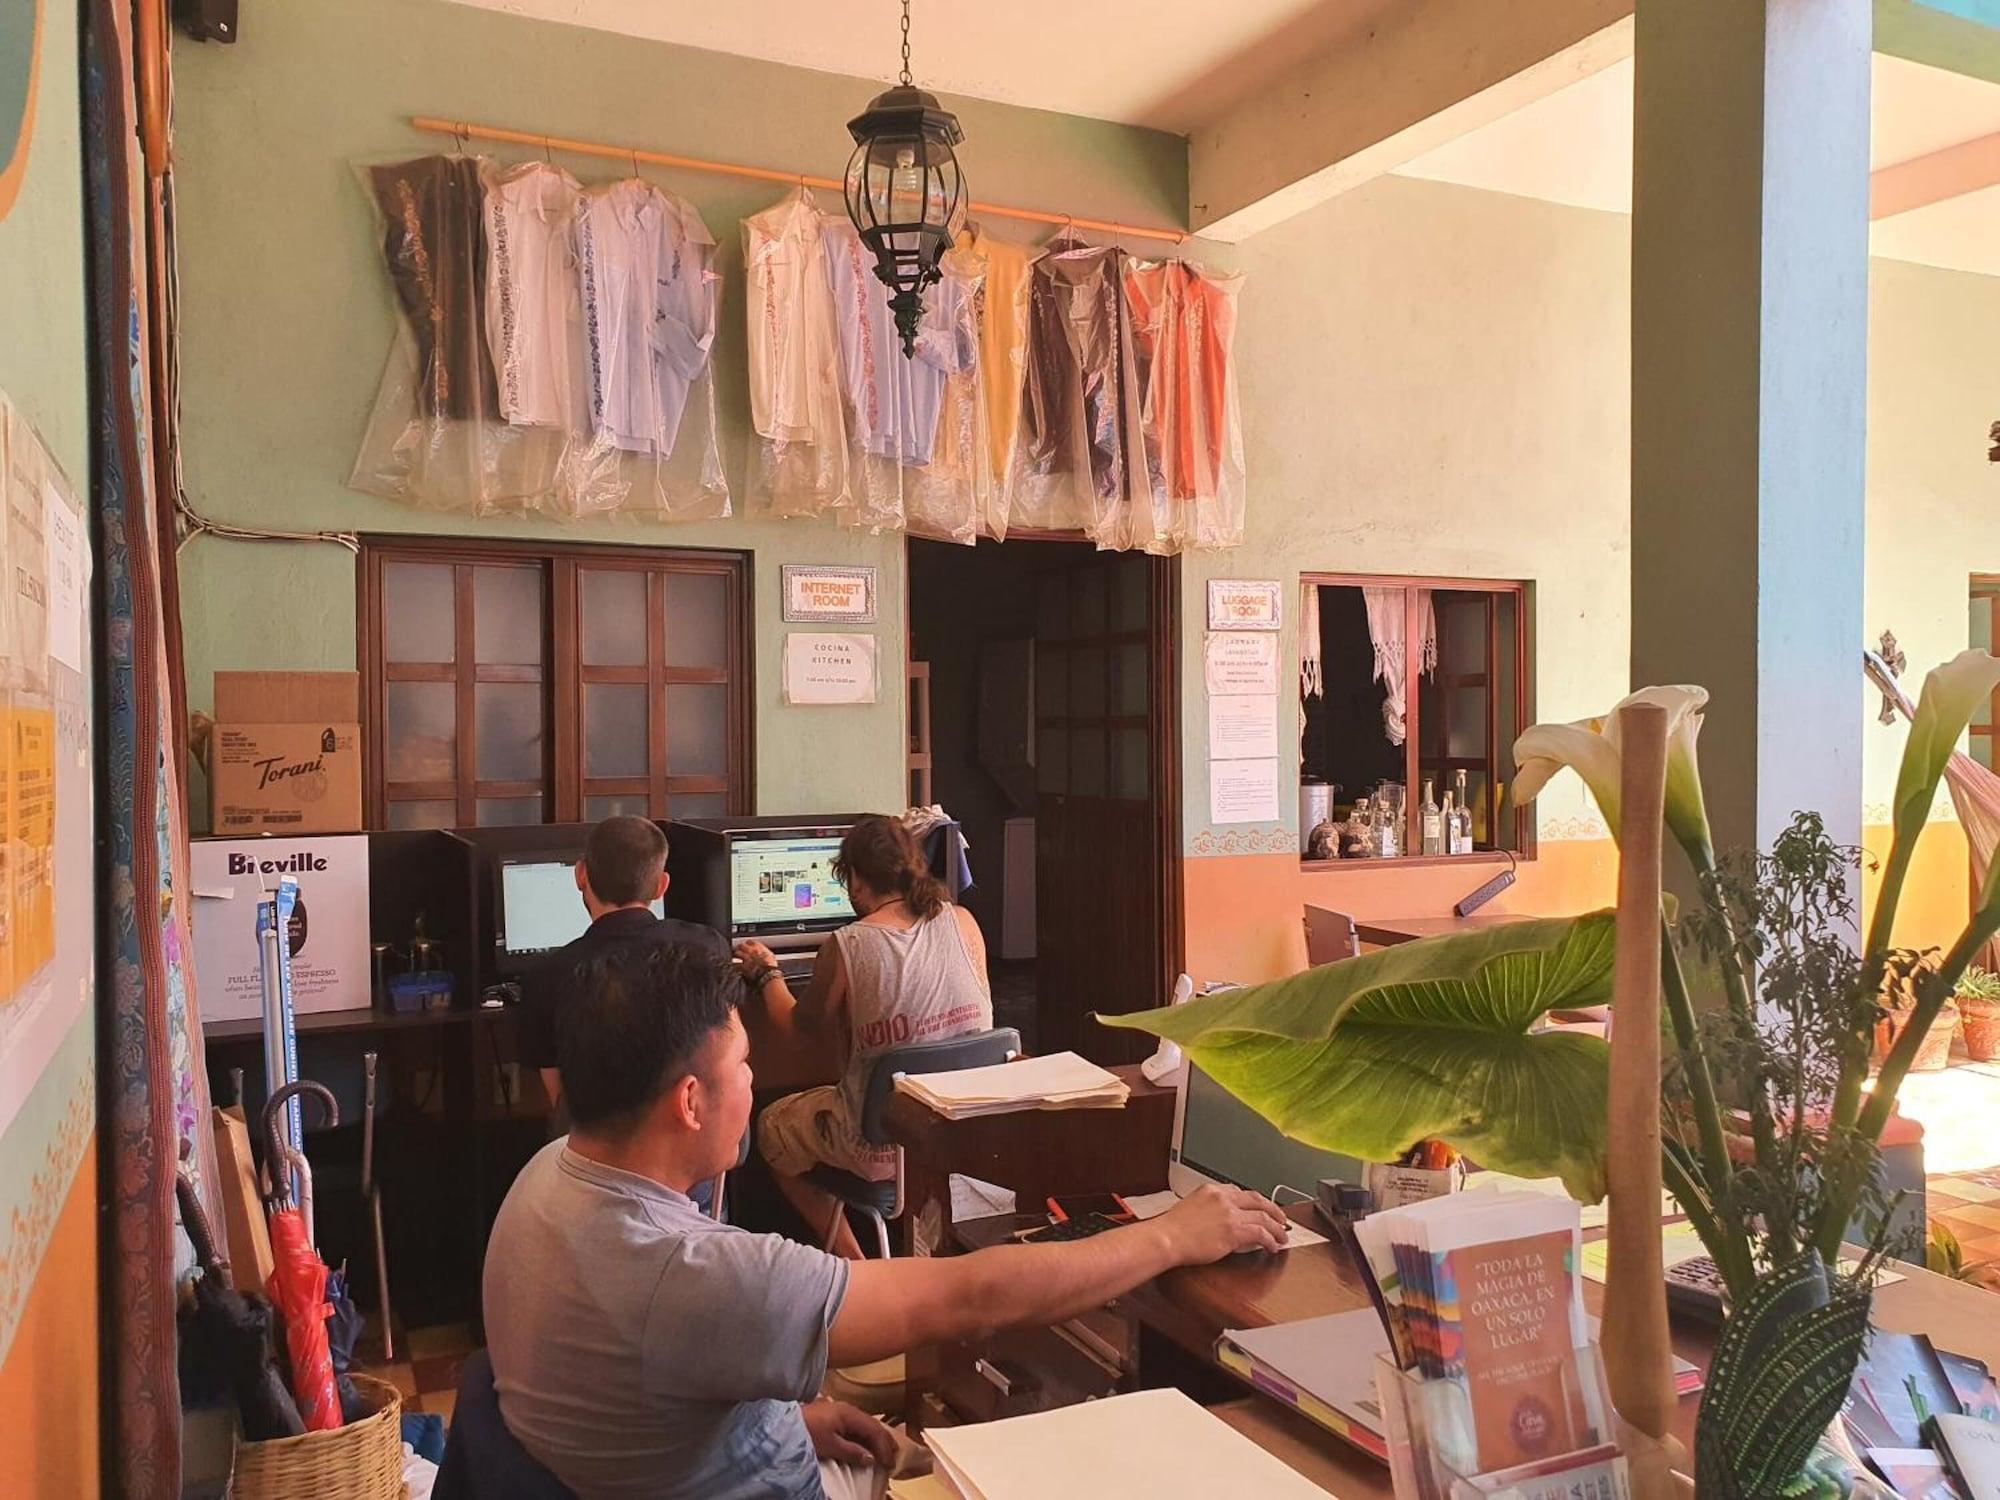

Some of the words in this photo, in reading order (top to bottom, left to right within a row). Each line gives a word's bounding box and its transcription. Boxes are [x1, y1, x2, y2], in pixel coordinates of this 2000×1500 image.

[800, 582, 862, 595] INTERNET
[812, 595, 850, 607] ROOM
[1222, 595, 1268, 606] LUGGAGE
[814, 643, 850, 651] COCINA
[811, 657, 852, 665] KITCHEN
[253, 754, 323, 790] Torani
[228, 853, 328, 875] Breville
[1524, 1253, 1543, 1269] LA
[1476, 1274, 1524, 1294] MAGIA
[1527, 1270, 1546, 1286] DE
[1536, 1285, 1554, 1303] EN
[1485, 1314, 1507, 1331] UN
[1509, 1305, 1546, 1325] SOLO
